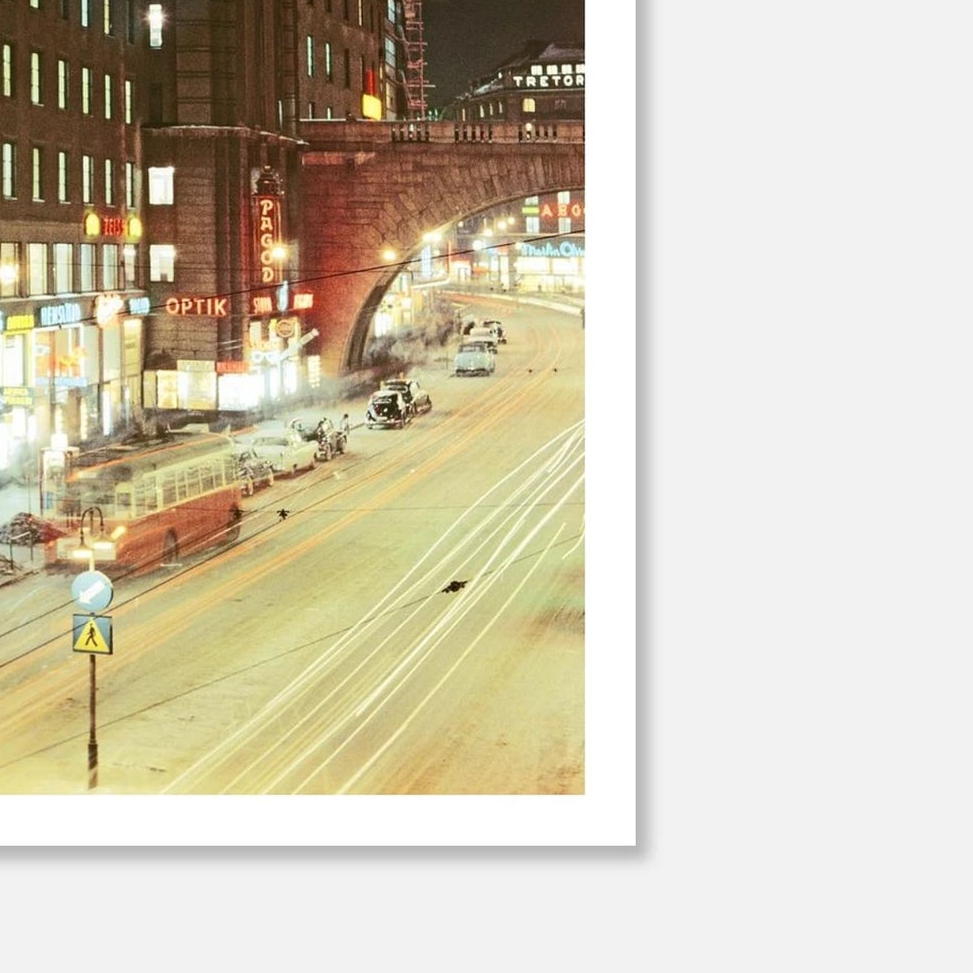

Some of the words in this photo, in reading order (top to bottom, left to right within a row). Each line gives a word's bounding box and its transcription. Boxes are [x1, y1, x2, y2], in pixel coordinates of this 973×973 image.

[513, 75, 585, 87] TRETOR
[259, 199, 275, 283] PAGOD
[165, 297, 228, 317] OPTIK
